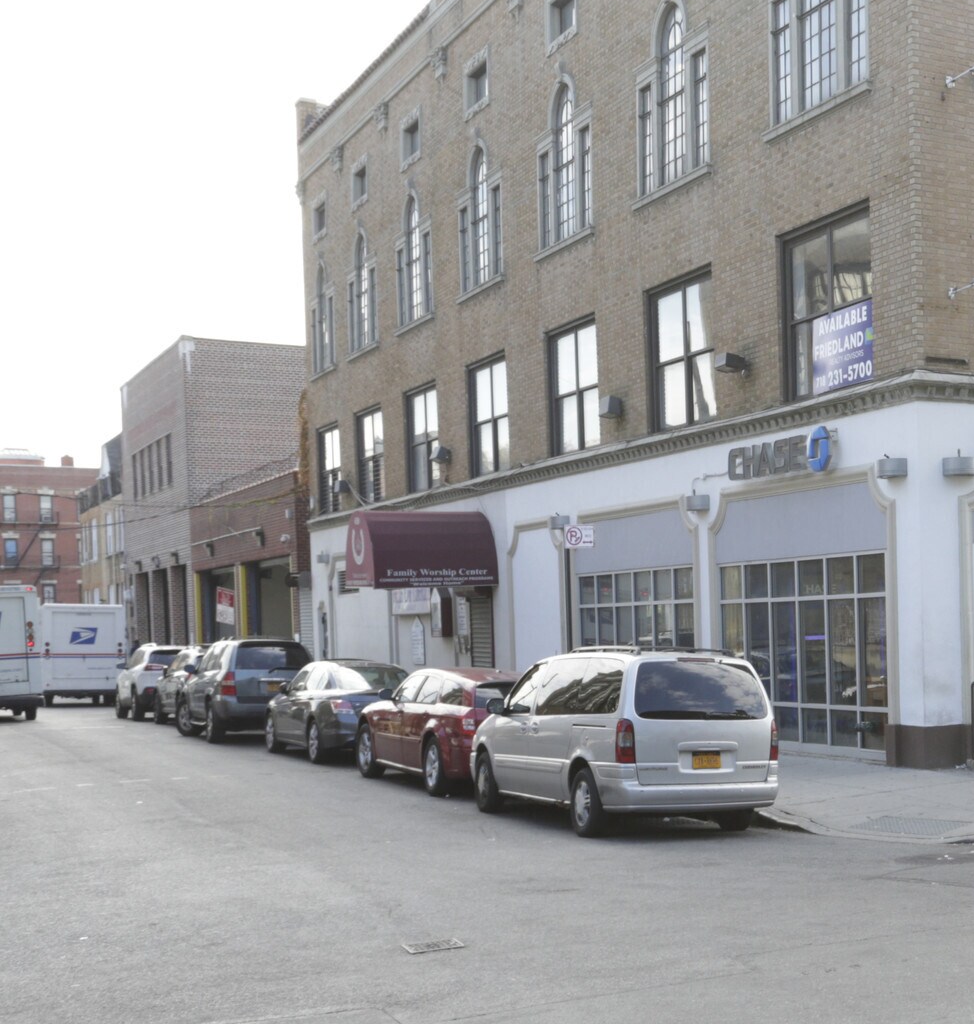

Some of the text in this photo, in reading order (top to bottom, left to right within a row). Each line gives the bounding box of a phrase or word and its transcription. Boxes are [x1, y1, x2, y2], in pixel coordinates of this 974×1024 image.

[818, 305, 868, 336] AVAILABLE
[814, 330, 864, 361] FRIEDLAND
[828, 360, 873, 387] 231-5700
[728, 434, 808, 481] CHASE
[387, 568, 488, 578] Family Worship Center
